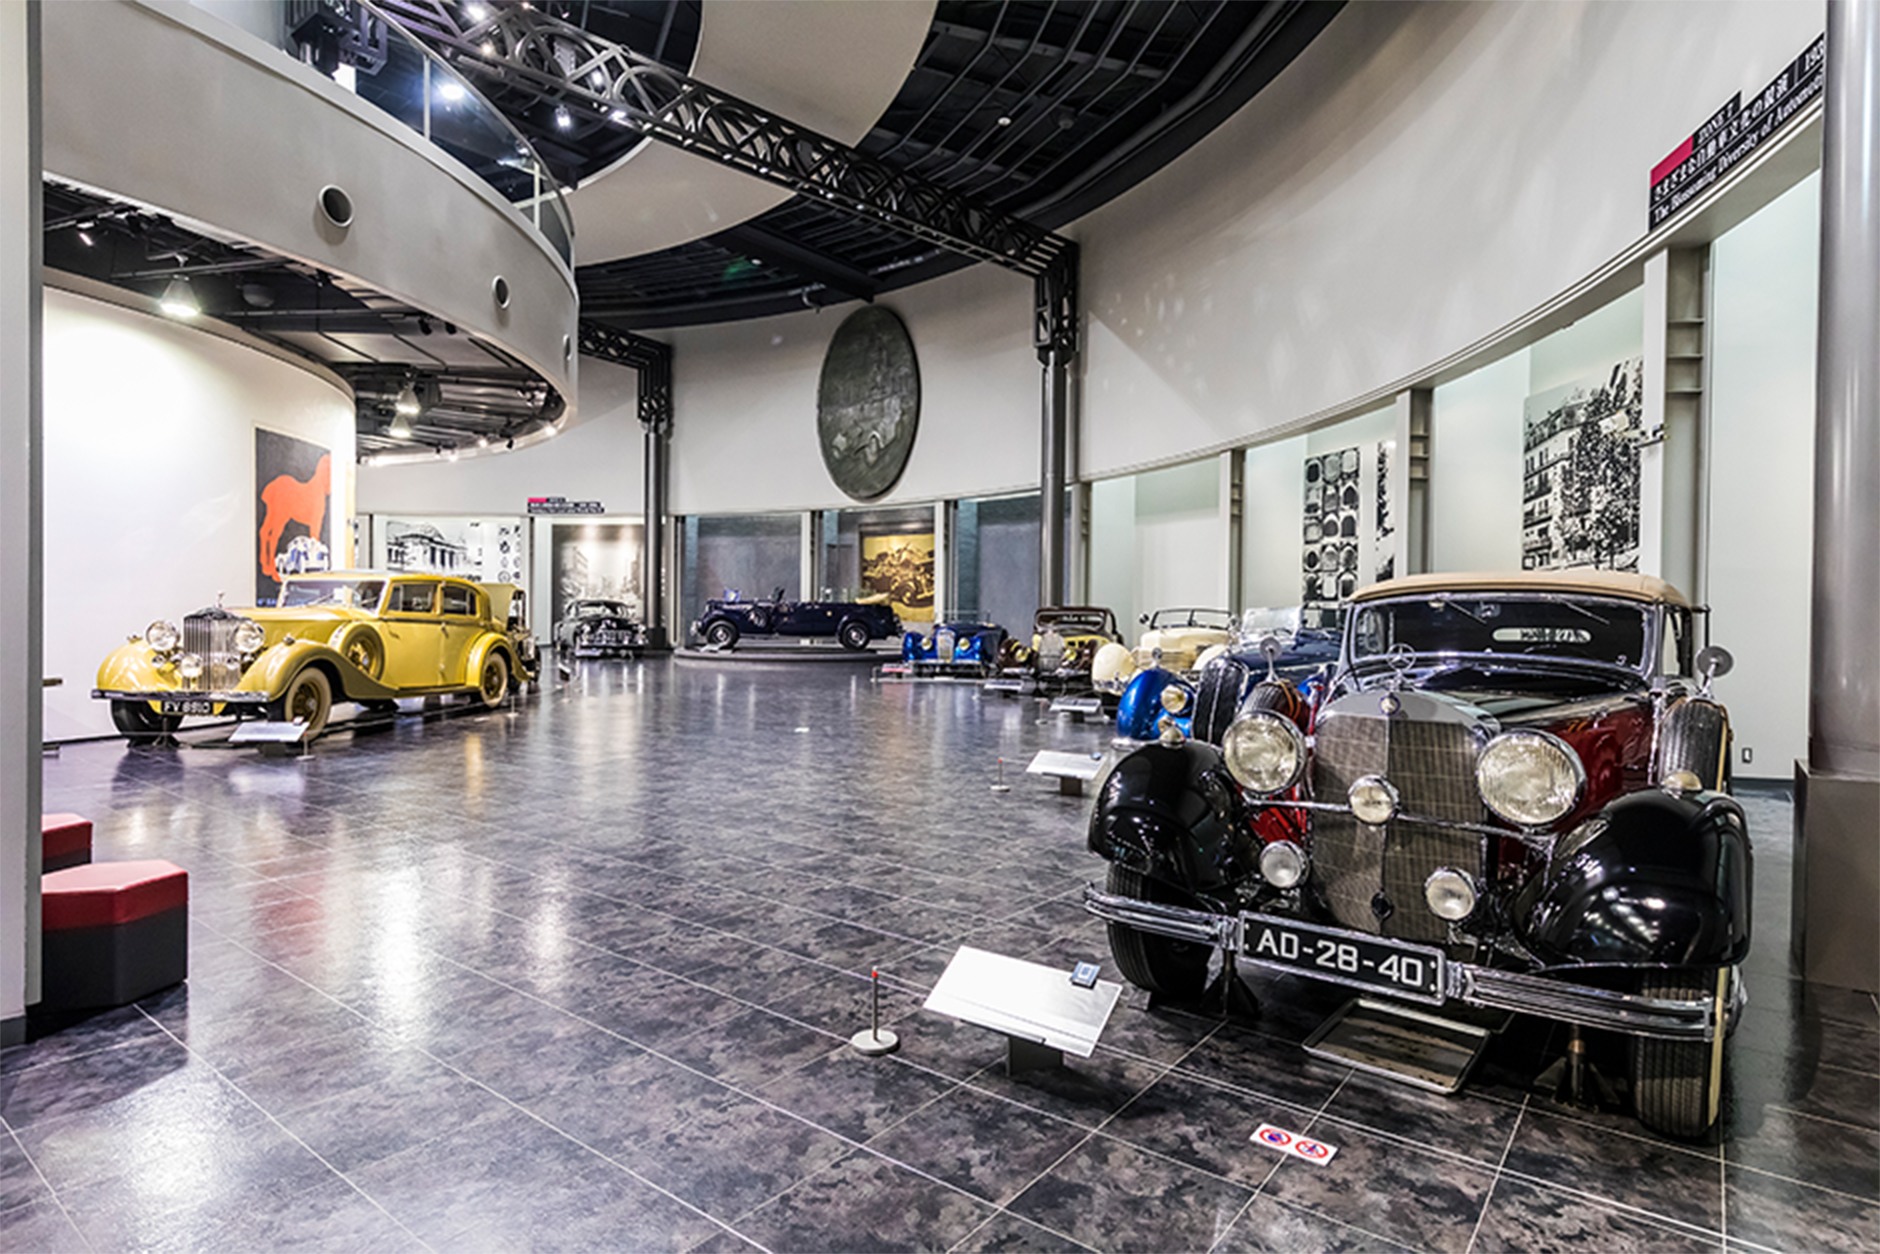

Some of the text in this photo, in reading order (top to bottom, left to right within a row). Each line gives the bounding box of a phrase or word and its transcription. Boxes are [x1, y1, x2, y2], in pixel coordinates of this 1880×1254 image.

[1653, 204, 1670, 223] The
[1718, 130, 1759, 172] Diversity
[1761, 112, 1774, 137] of
[1256, 928, 1423, 987] AD-28-40
